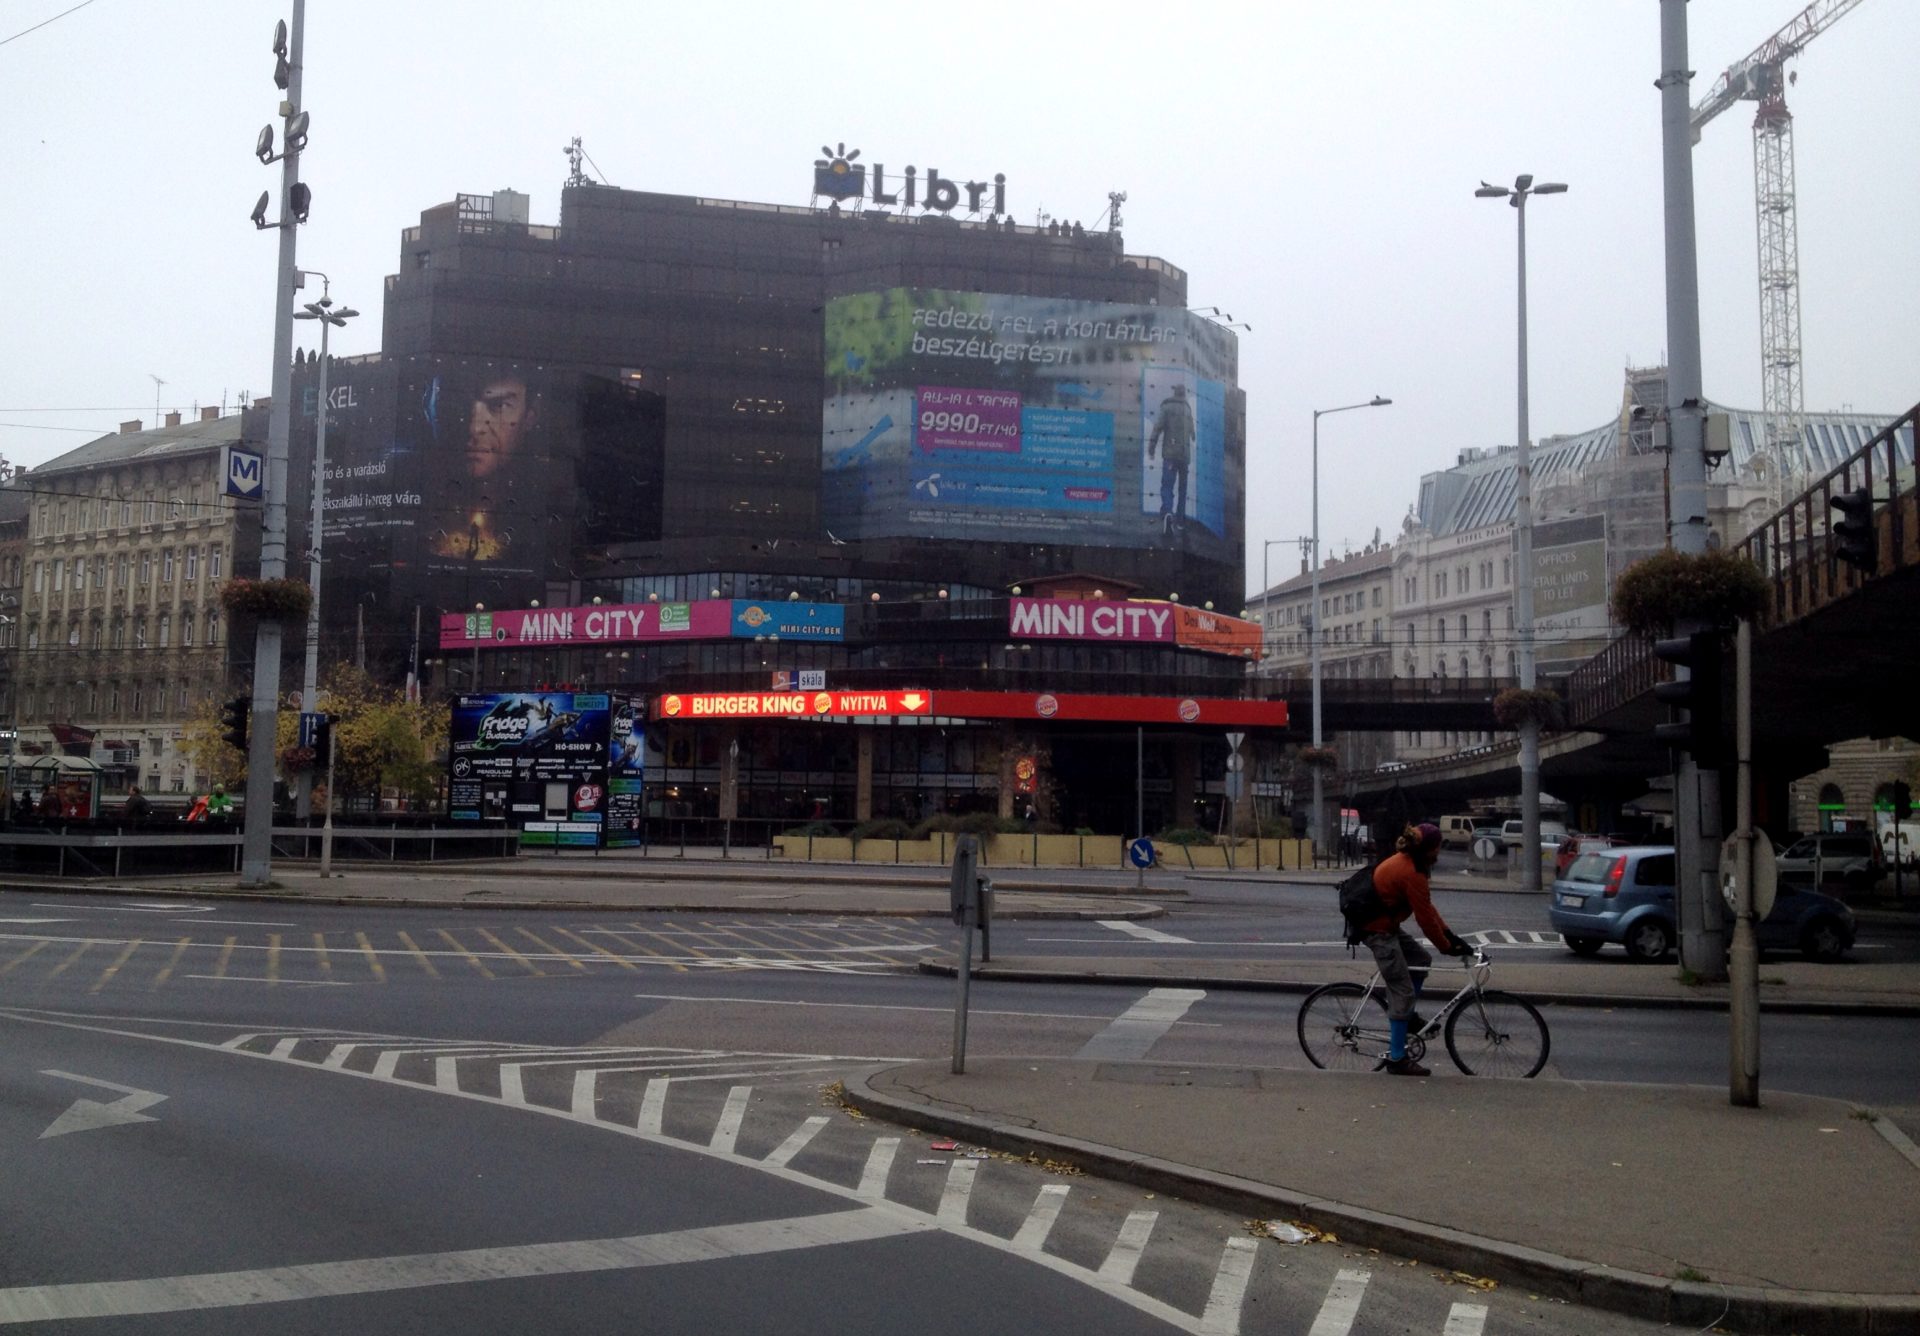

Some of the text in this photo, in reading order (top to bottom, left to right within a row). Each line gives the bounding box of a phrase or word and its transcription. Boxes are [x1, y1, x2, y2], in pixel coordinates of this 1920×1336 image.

[873, 163, 1006, 214] Libri
[921, 411, 979, 434] 9990
[232, 455, 258, 481] M
[322, 493, 363, 510] ékszakállú
[395, 490, 422, 505] vára
[1538, 551, 1577, 566] OFFICES
[1533, 570, 1590, 588] ETAIL UNITS
[519, 612, 573, 642] MINI
[585, 609, 645, 639] CITY
[1011, 602, 1170, 638] MINI CITY
[801, 673, 823, 687] skála
[692, 695, 887, 714] BURGER KING NYITVA
[482, 716, 529, 732] Fridge
[485, 730, 523, 740] Budapest
